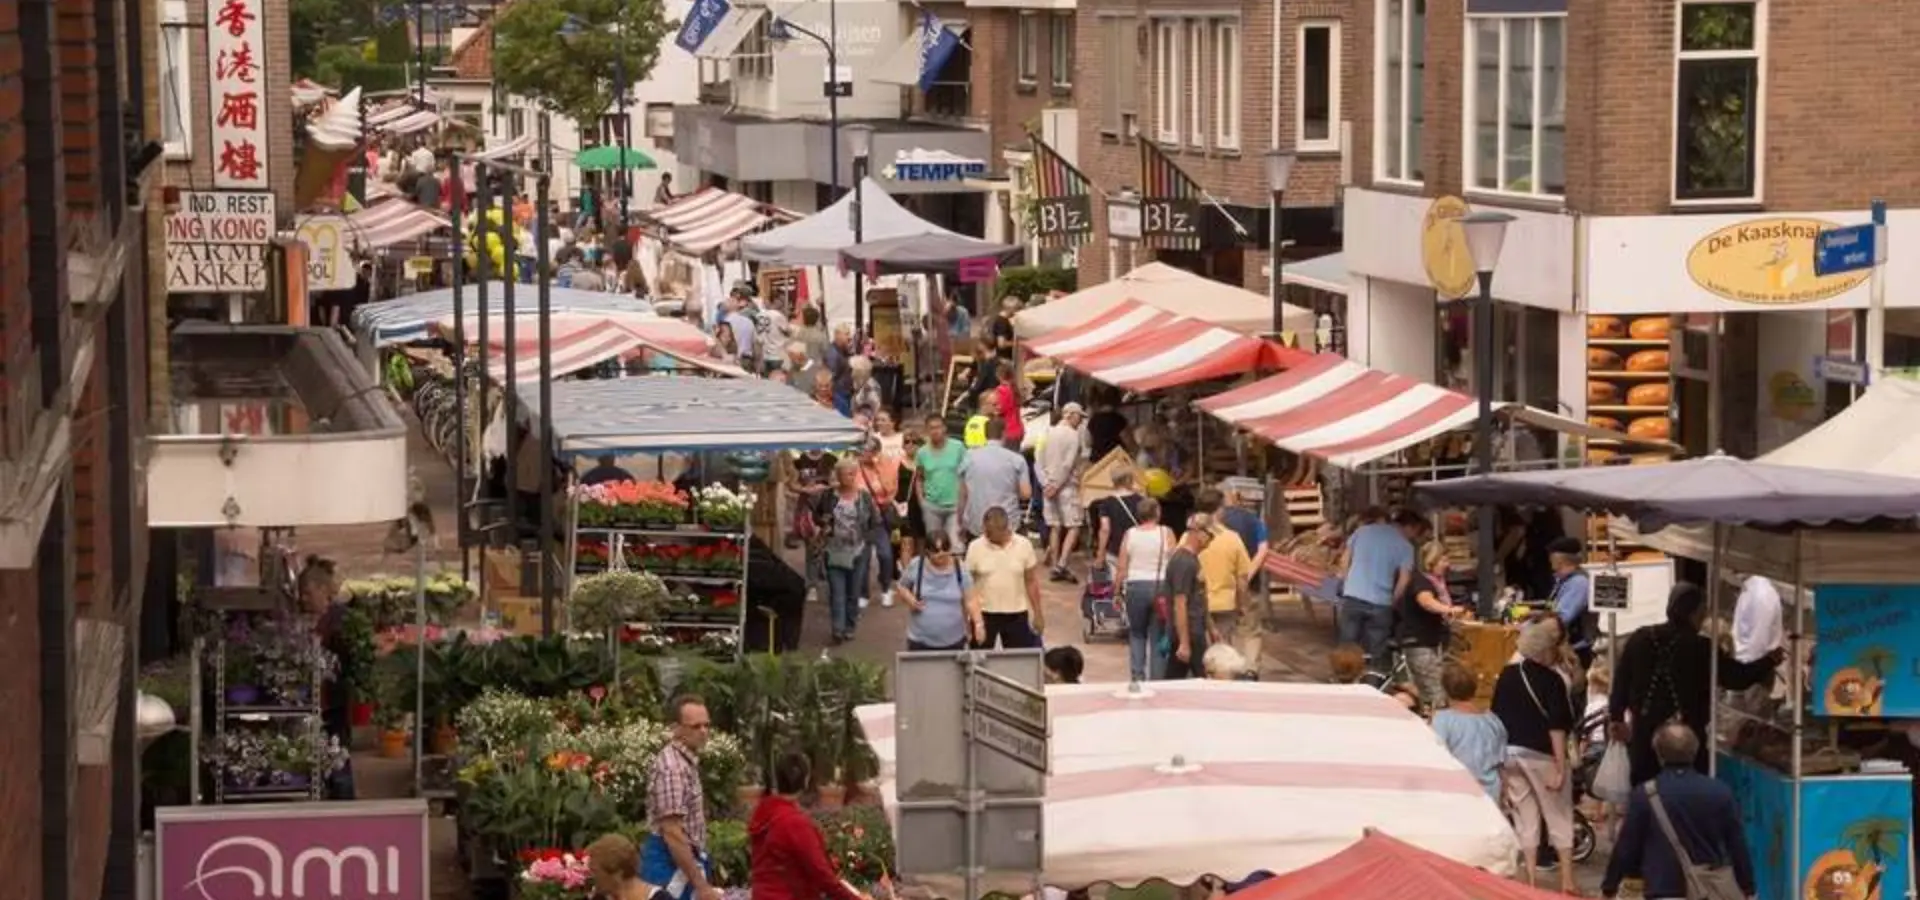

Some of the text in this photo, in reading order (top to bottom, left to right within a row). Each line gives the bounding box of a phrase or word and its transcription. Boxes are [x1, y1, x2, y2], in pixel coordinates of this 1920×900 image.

[226, 196, 272, 213] REST.
[211, 218, 267, 240] KONG
[1708, 236, 1733, 254] De
[1737, 221, 1821, 244] Kaaskna
